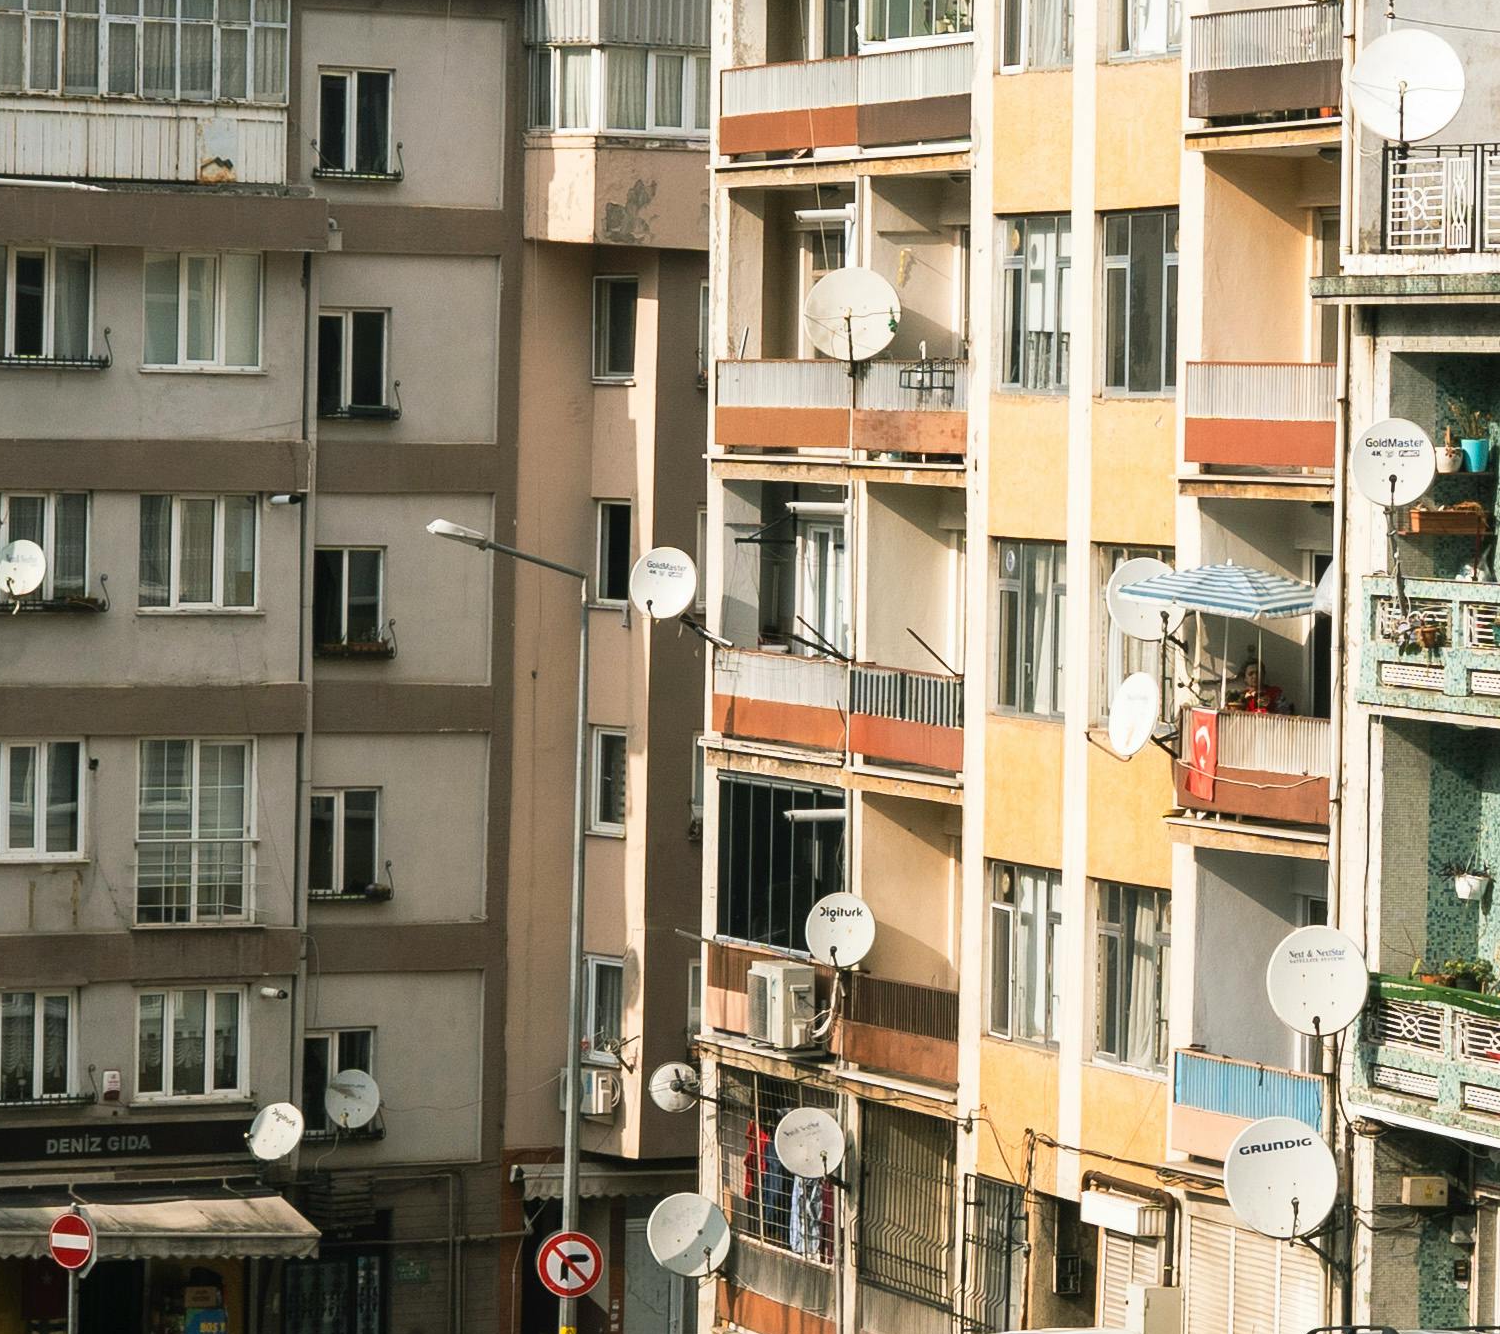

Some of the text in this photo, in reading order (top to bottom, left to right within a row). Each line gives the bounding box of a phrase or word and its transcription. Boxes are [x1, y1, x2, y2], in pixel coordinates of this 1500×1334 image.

[1365, 438, 1424, 448] GoldMaster
[820, 907, 863, 922] Digiturk
[1289, 949, 1346, 958] Next & NextStar
[46, 1133, 151, 1154] DENİZ GIDA
[1239, 1138, 1312, 1155] GRUNDIG
